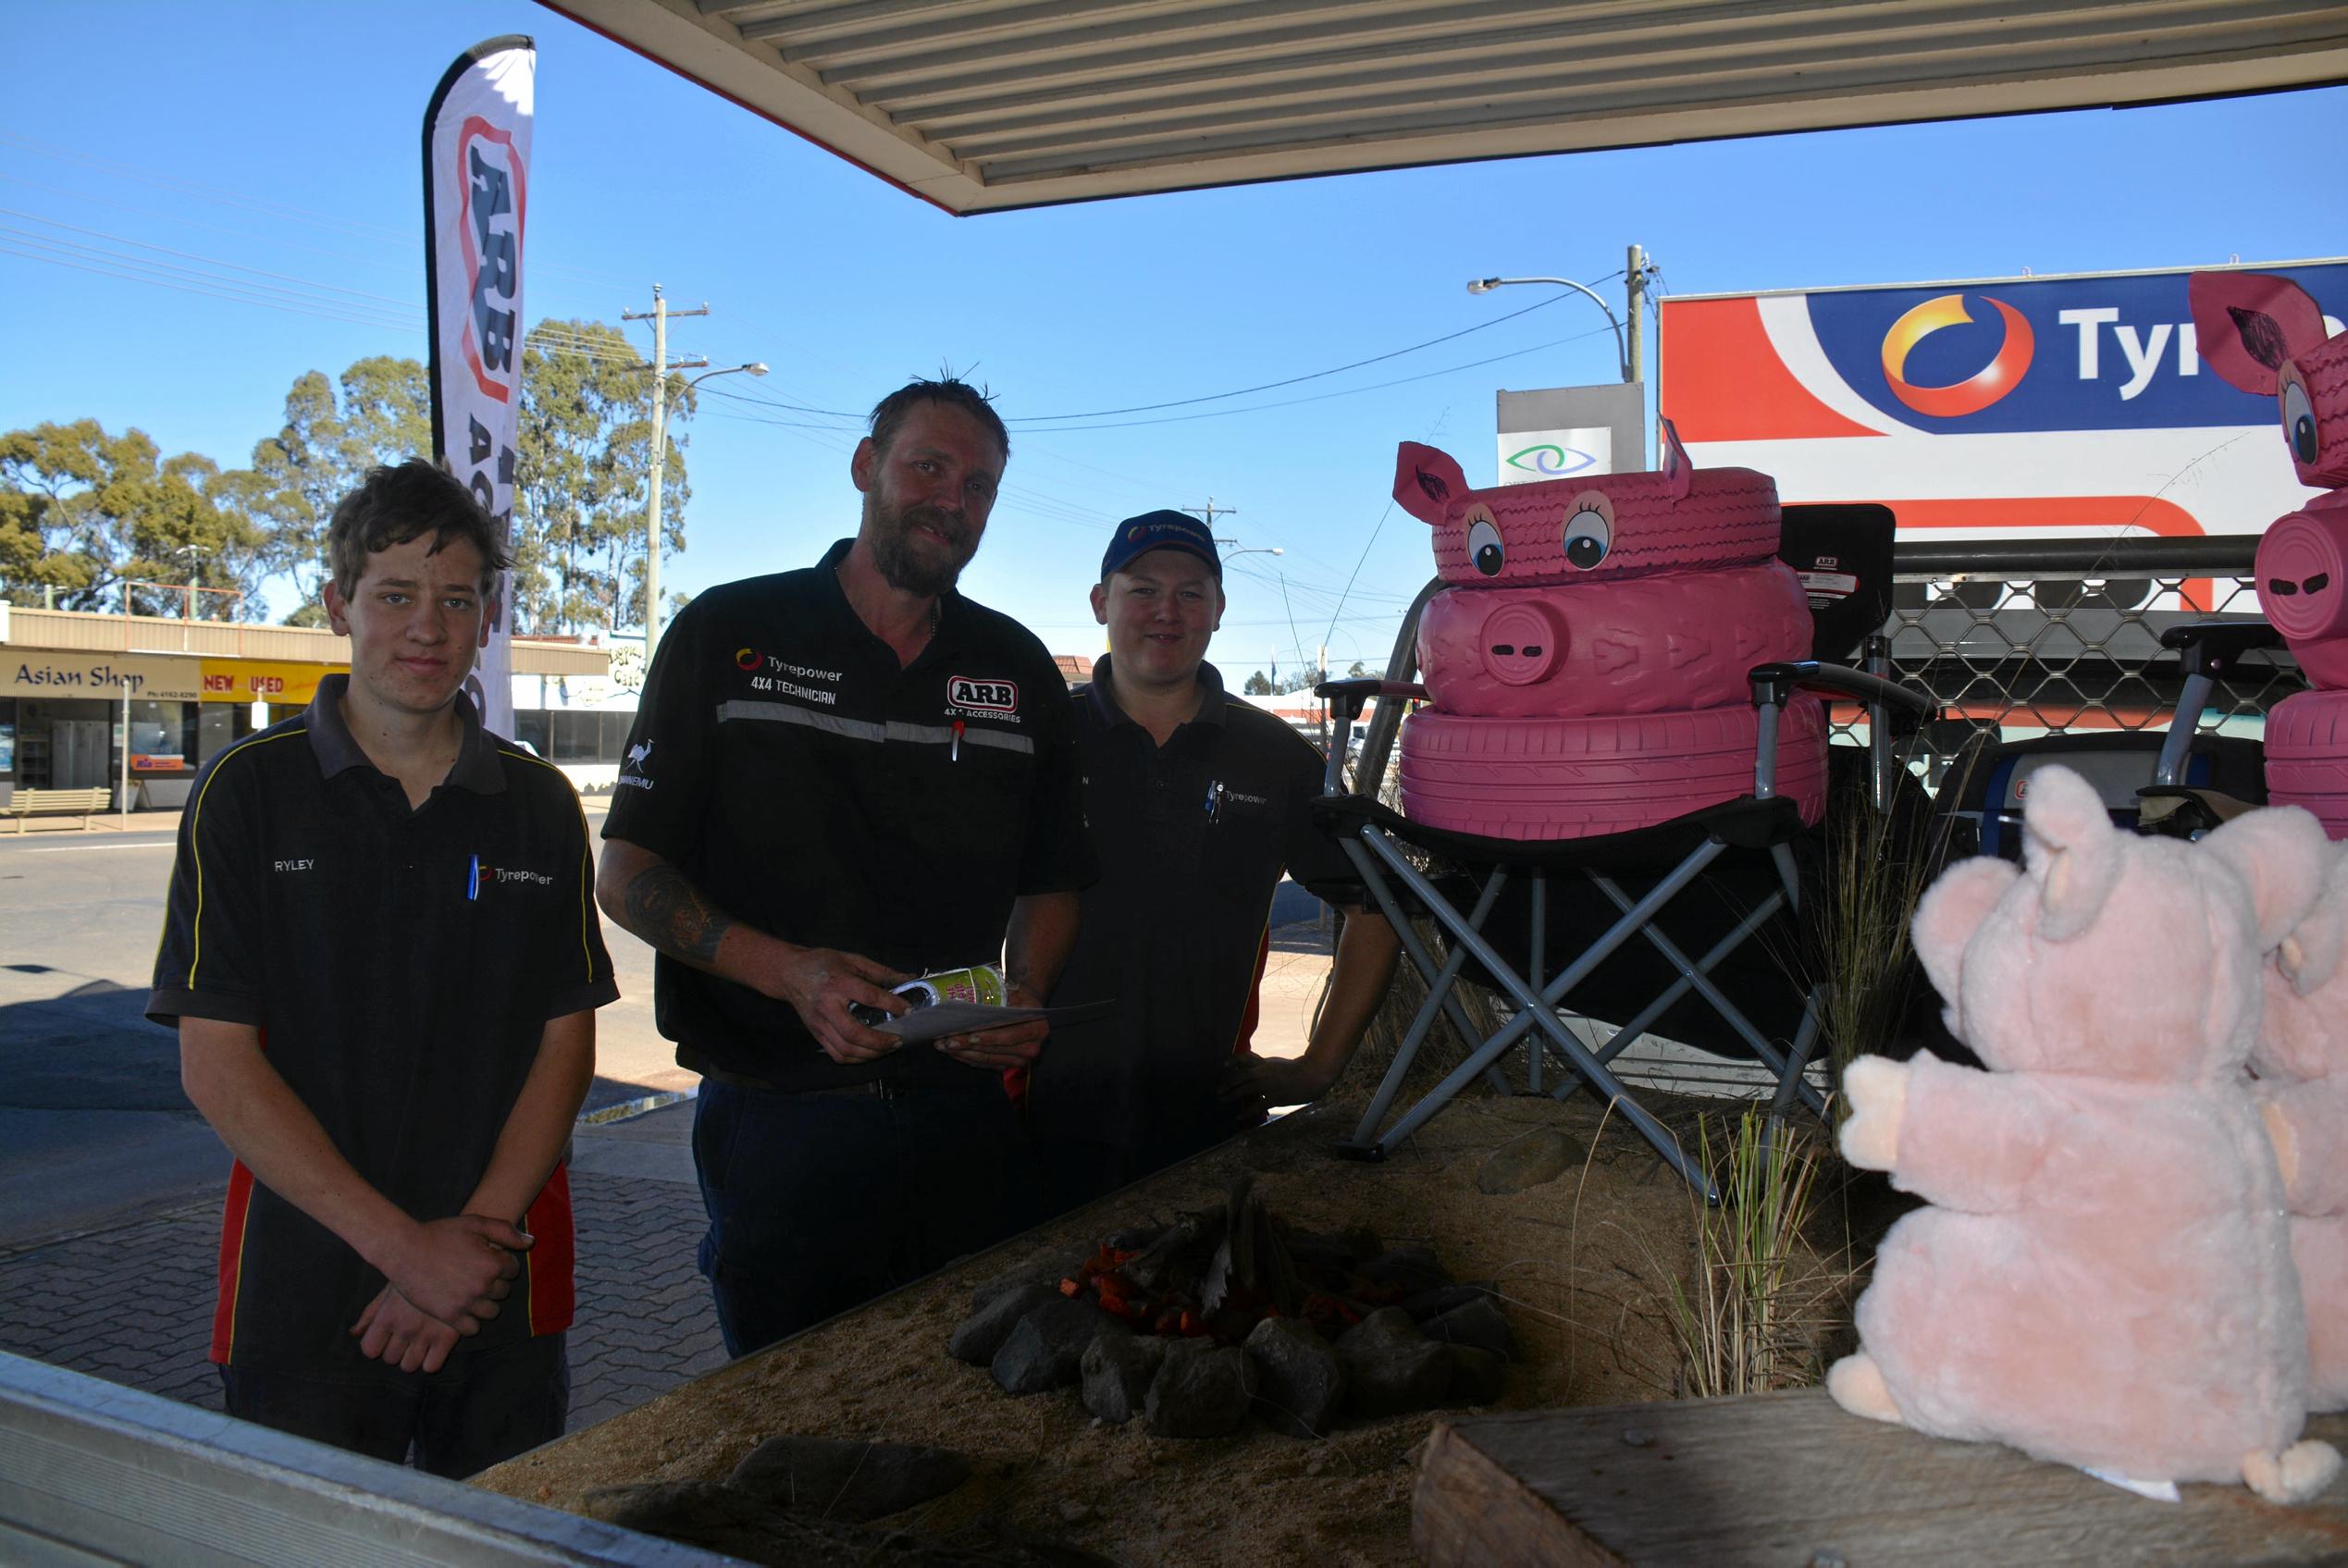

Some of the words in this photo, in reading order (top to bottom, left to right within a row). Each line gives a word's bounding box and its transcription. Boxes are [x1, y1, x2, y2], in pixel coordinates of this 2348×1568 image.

[469, 143, 518, 375] ARB
[15, 663, 82, 685] Asian
[90, 665, 144, 693] Shop
[767, 656, 843, 682] Tyrepower
[204, 674, 234, 692] NEW
[250, 676, 284, 693] USED
[750, 676, 772, 691] 4X4
[775, 680, 836, 705] TECHNICIAN
[956, 682, 1013, 706] ARB
[966, 710, 1020, 723] ACCESSORIES
[275, 858, 315, 872] RYLEY
[495, 868, 553, 885] Tyrepower
